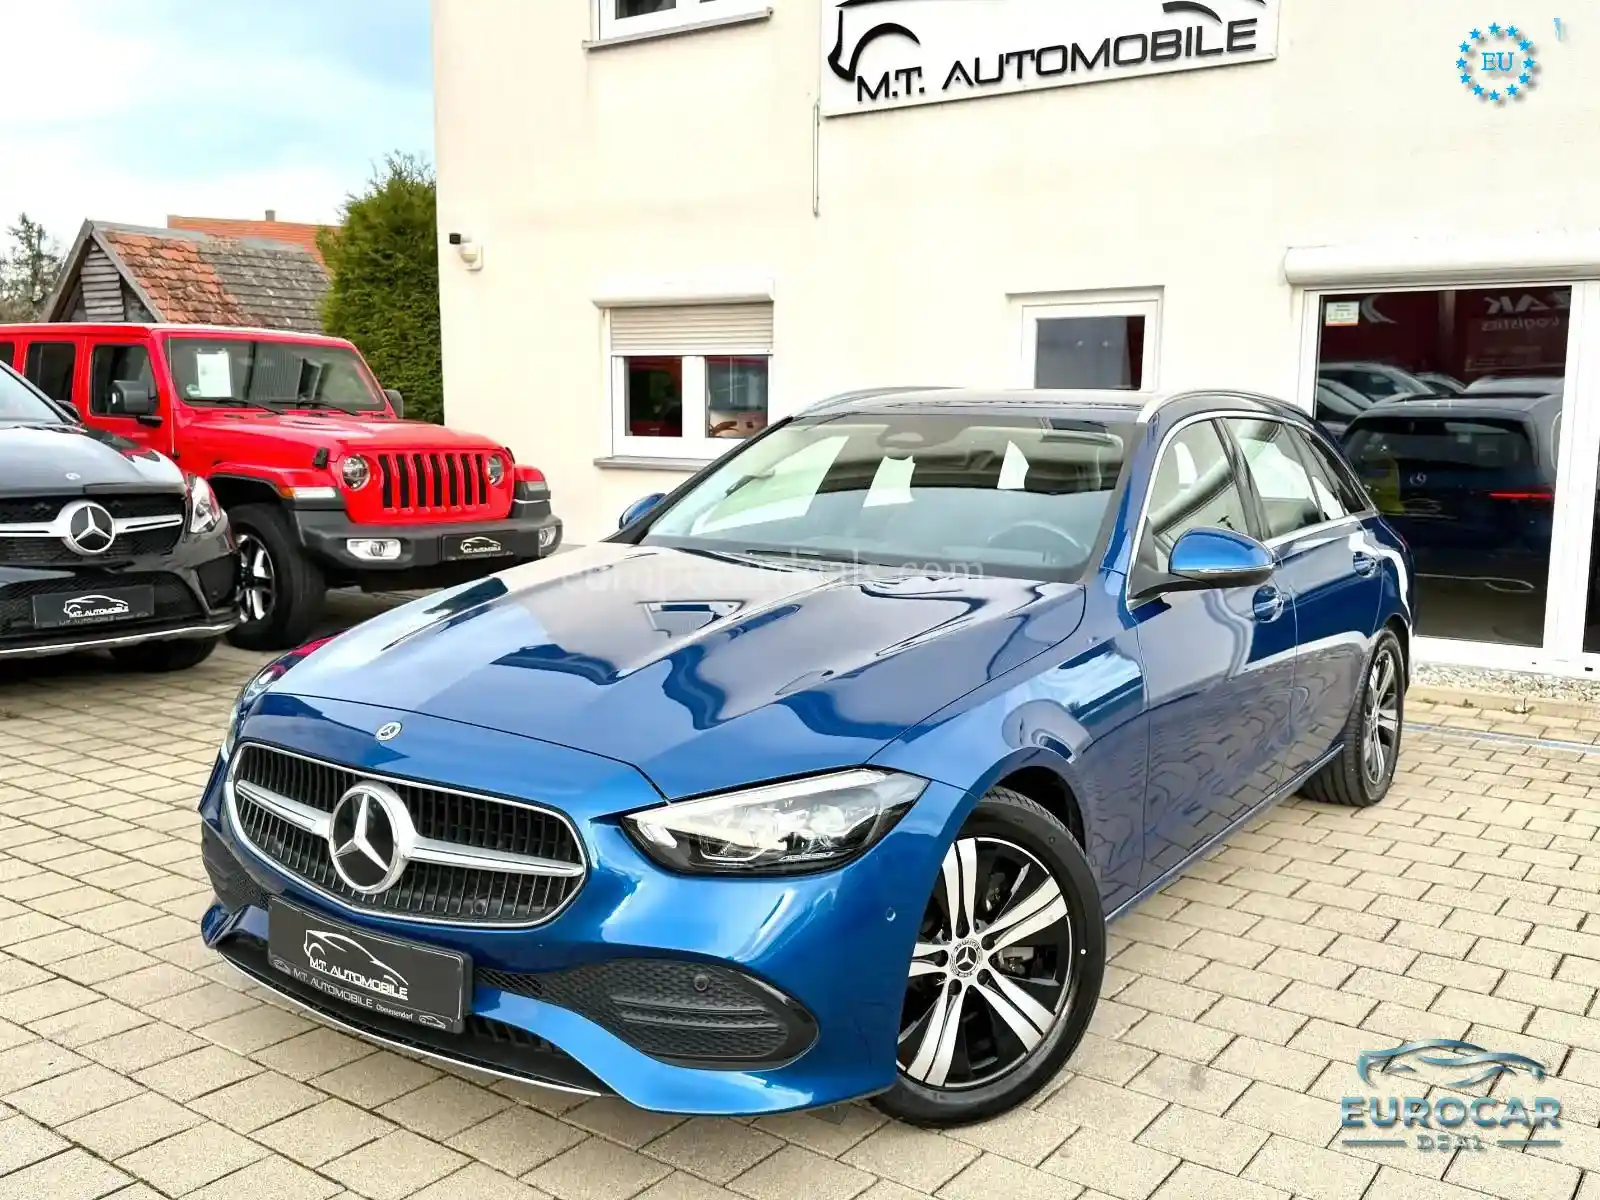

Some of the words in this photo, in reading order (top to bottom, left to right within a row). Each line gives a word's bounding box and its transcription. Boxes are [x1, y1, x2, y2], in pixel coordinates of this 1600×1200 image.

[857, 66, 926, 102] M.T.
[942, 18, 1258, 91] AUTOMOBILE
[311, 977, 373, 1008] AUTOMOBILE
[331, 965, 408, 1000] AUTOMOBILE
